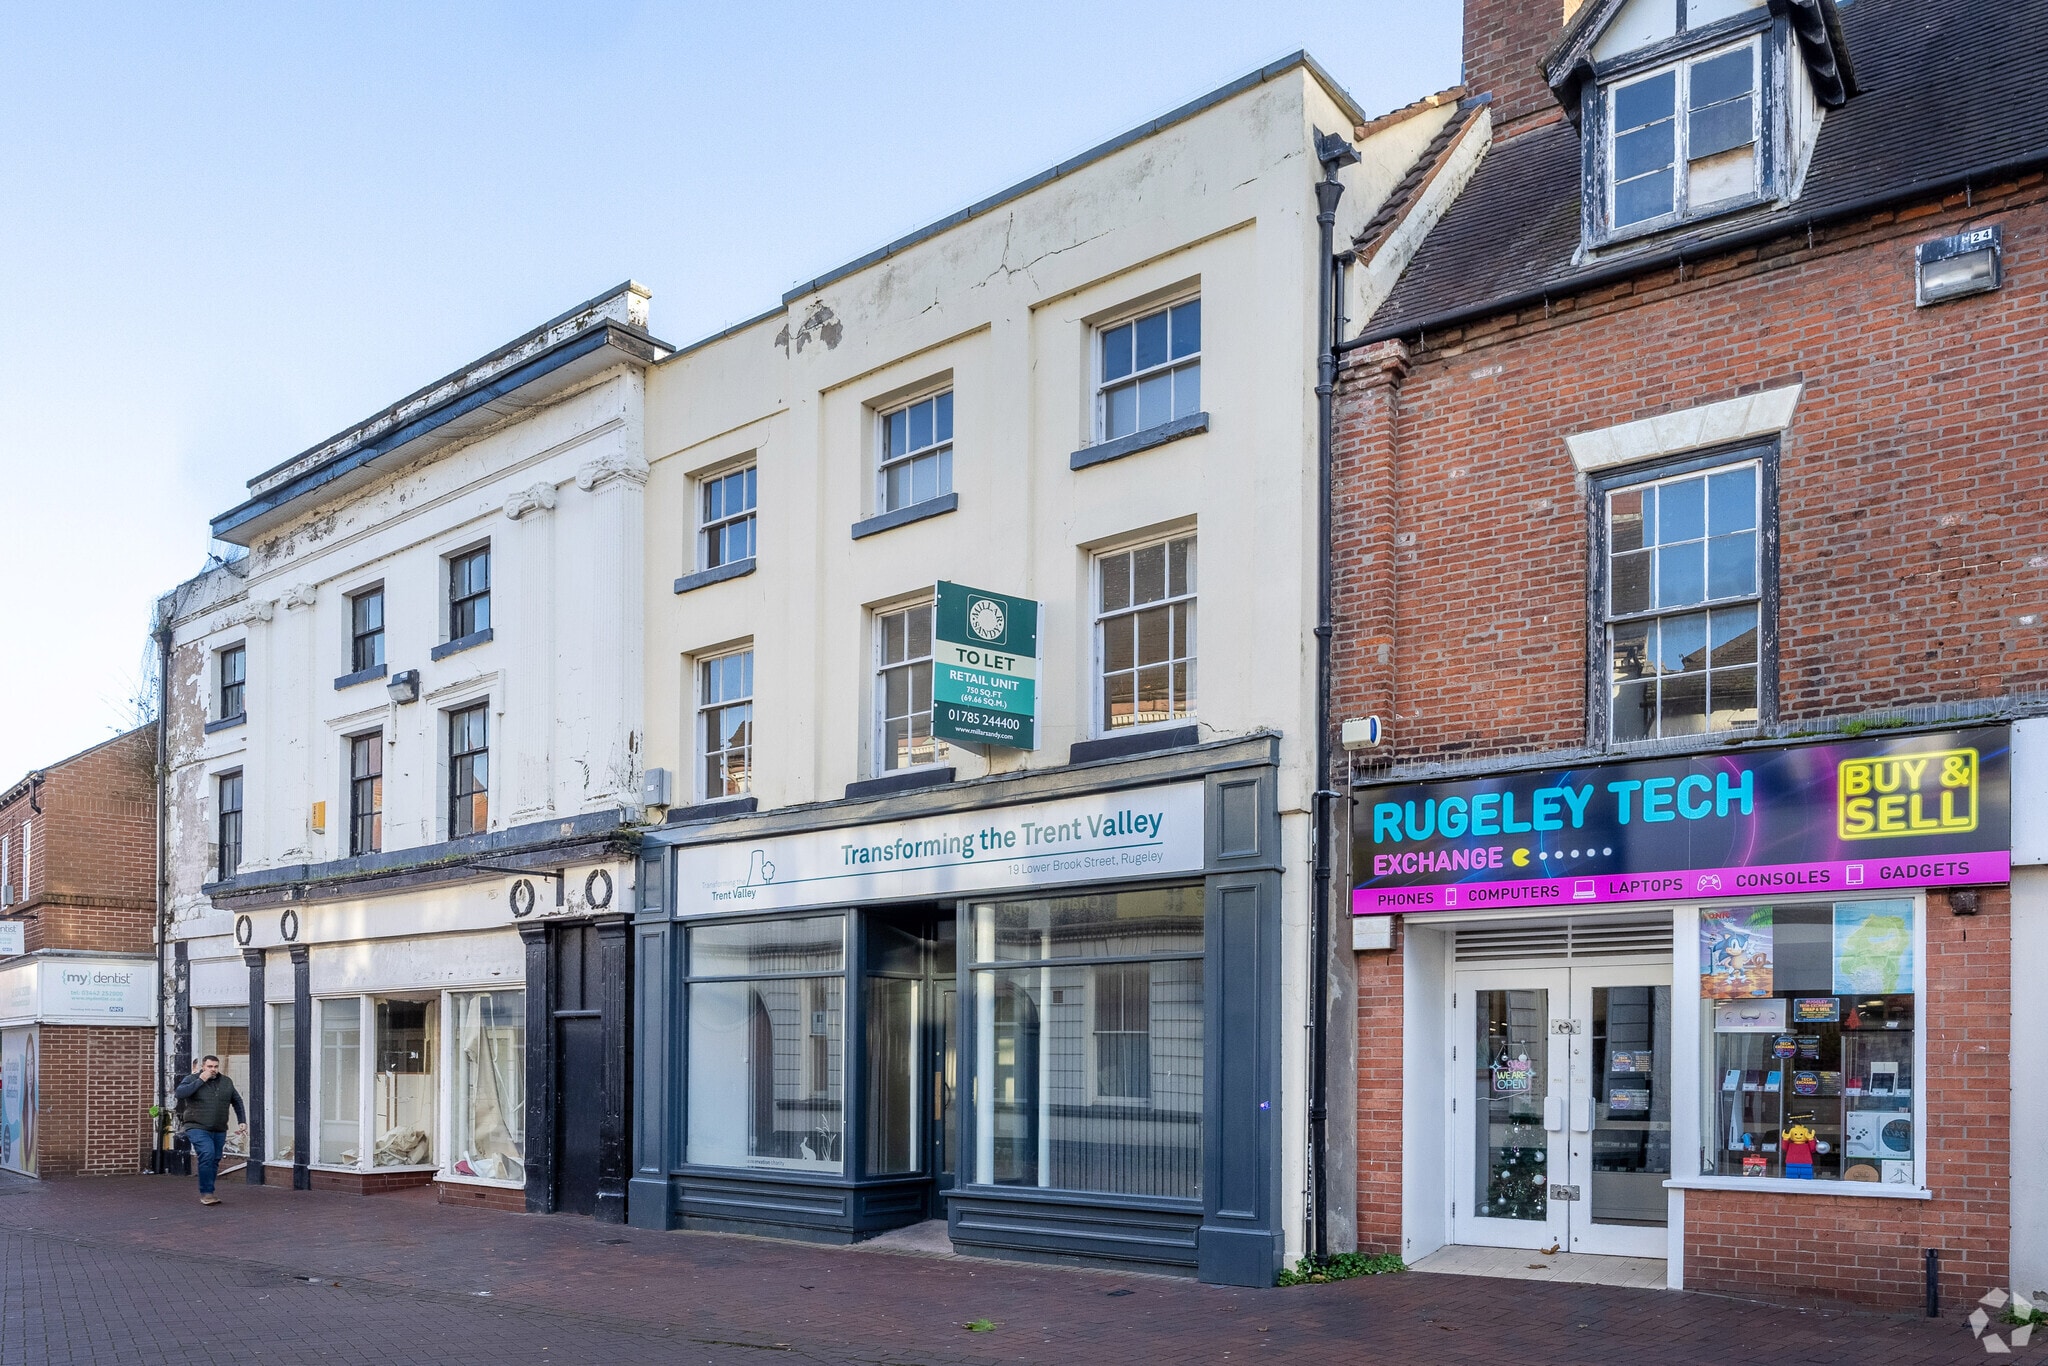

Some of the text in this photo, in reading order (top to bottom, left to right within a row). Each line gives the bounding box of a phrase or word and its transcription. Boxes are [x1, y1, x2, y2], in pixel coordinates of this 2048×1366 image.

[971, 602, 1003, 622] MILLAR
[973, 621, 1001, 638] SANDY
[956, 648, 1016, 671] TO LET
[949, 670, 1020, 691] RETAIL UNIT
[961, 694, 1008, 709] (69.66 SQ.M.)
[966, 686, 1003, 698] 750 SQ.FT
[948, 709, 1020, 730] 01785 244400
[955, 726, 1014, 740] www.millarsandy.com
[1845, 756, 1970, 796] BUY &
[1373, 769, 1754, 844] RUGELEY TECH
[1845, 790, 1970, 833] SELL
[841, 810, 1164, 866] Transforming the Trent Valley
[1008, 851, 1164, 876] 19 Lower Brook Street, Rugeley
[1373, 846, 1504, 876] EXCHANGE
[1378, 861, 1970, 906] PHONES COMPUTERS LAPTOPS CONSOLES GADGETS
[712, 888, 757, 901] Trent Valley
[93, 971, 131, 984] dentist
[1497, 1080, 1527, 1089] OPEN
[1512, 1071, 1526, 1079] ARE
